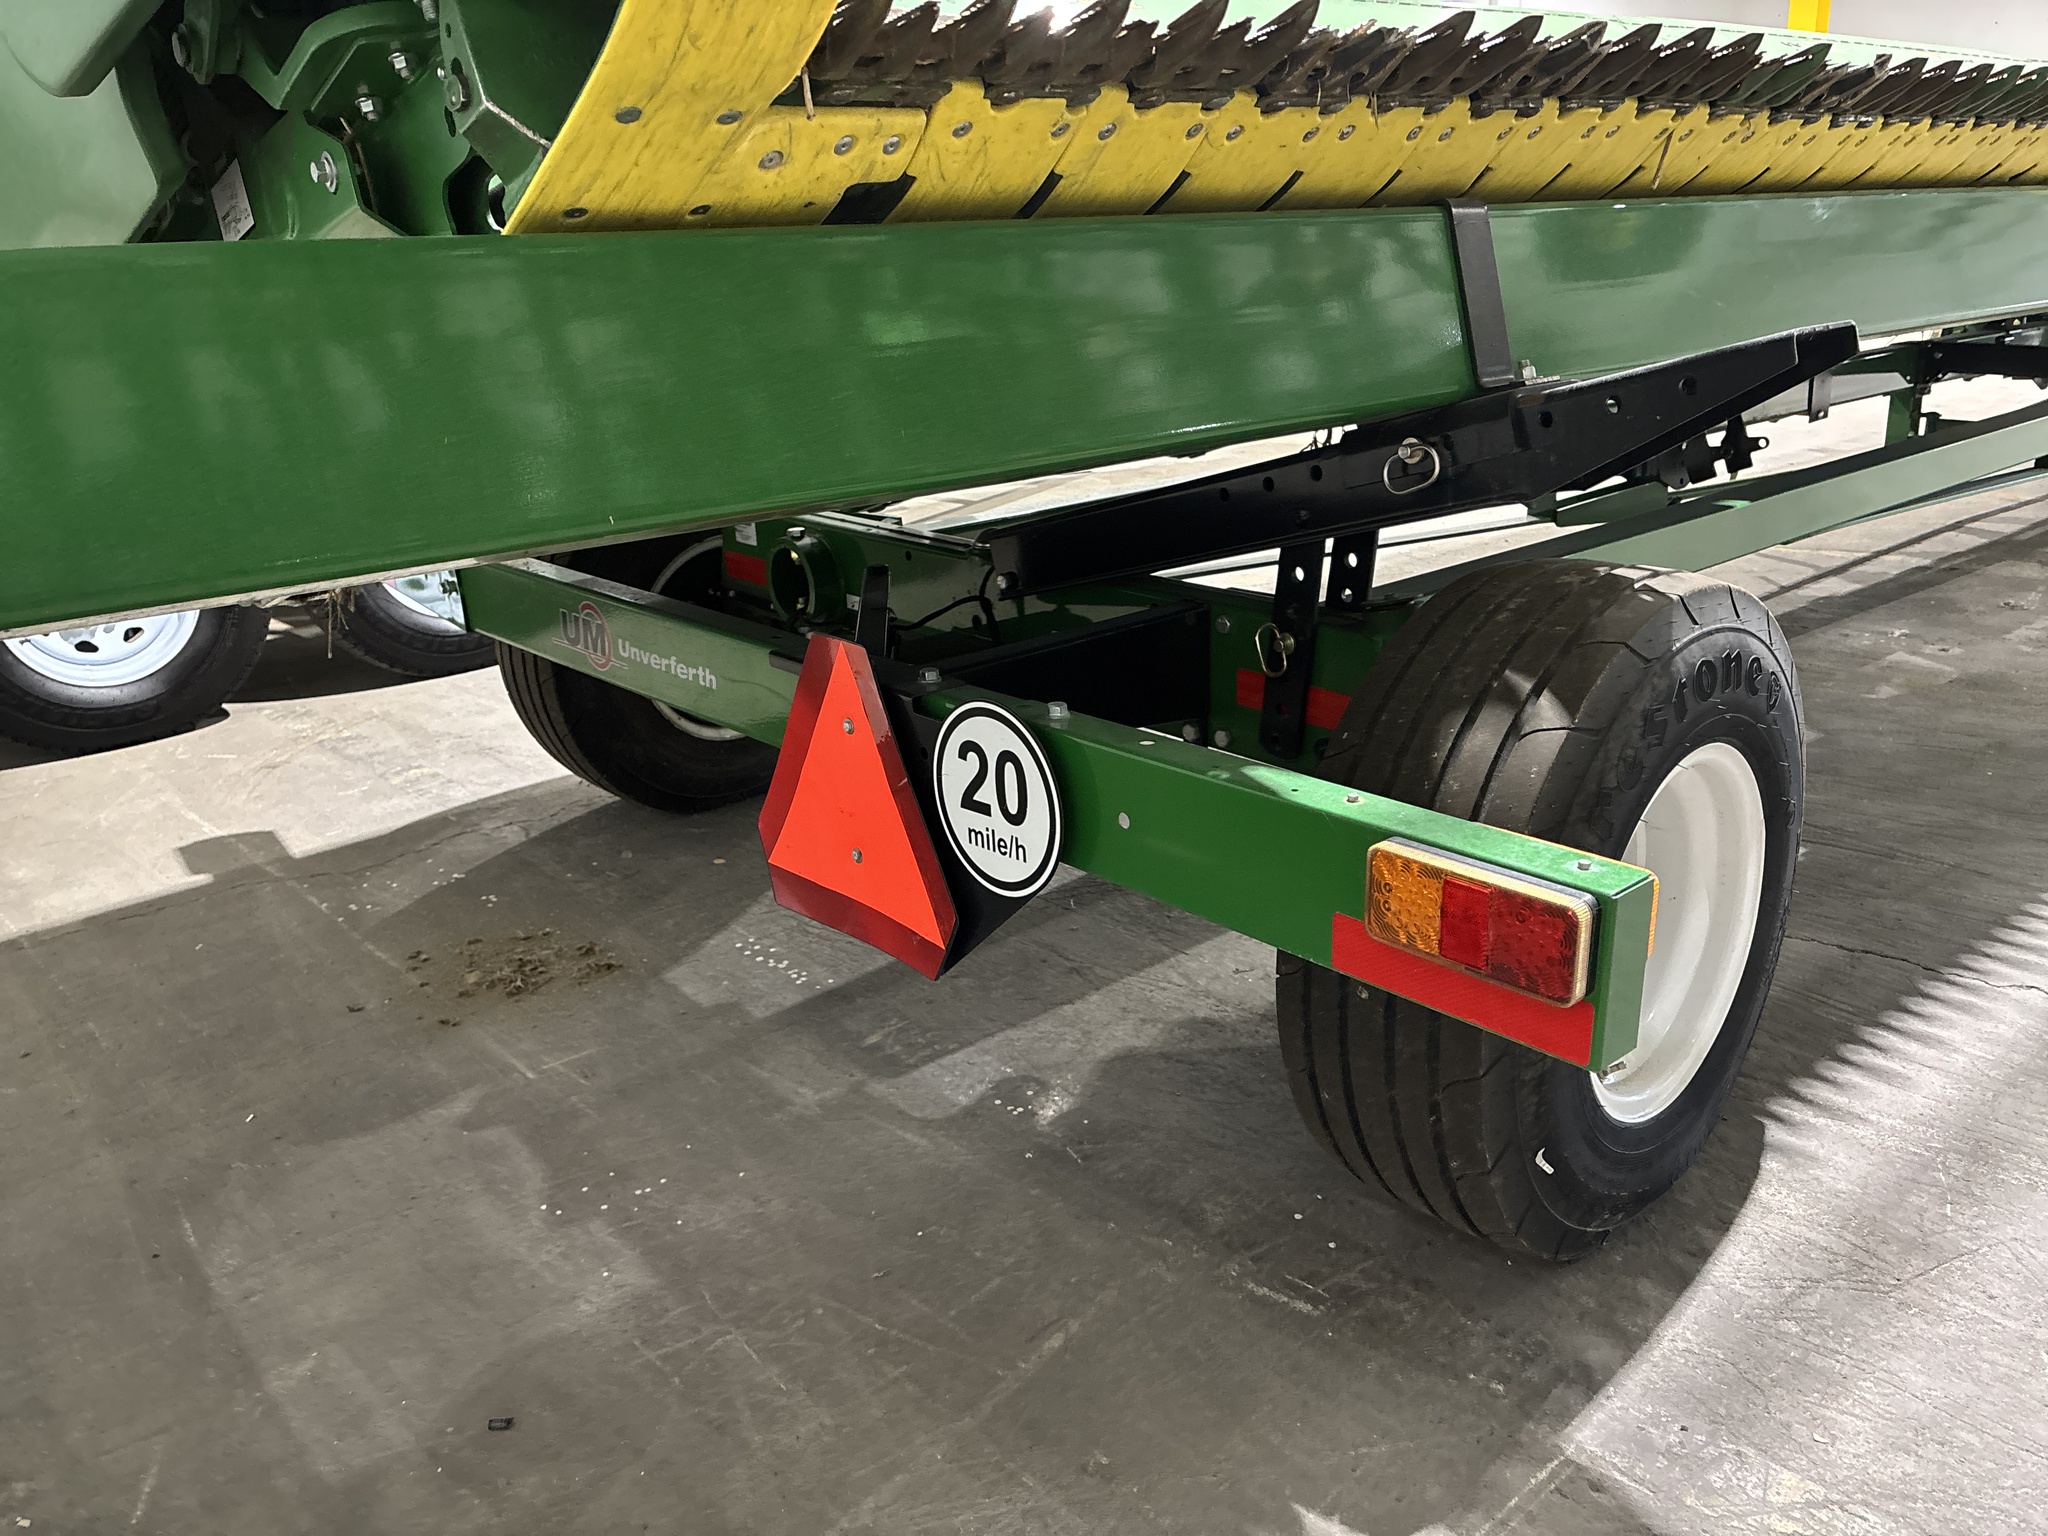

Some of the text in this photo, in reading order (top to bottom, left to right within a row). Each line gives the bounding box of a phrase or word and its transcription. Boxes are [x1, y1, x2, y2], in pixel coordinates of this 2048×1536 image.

[559, 608, 718, 690] UM Unverferth
[957, 739, 1028, 827] 20
[1589, 648, 1764, 842] restone
[967, 826, 1028, 863] mile/h
